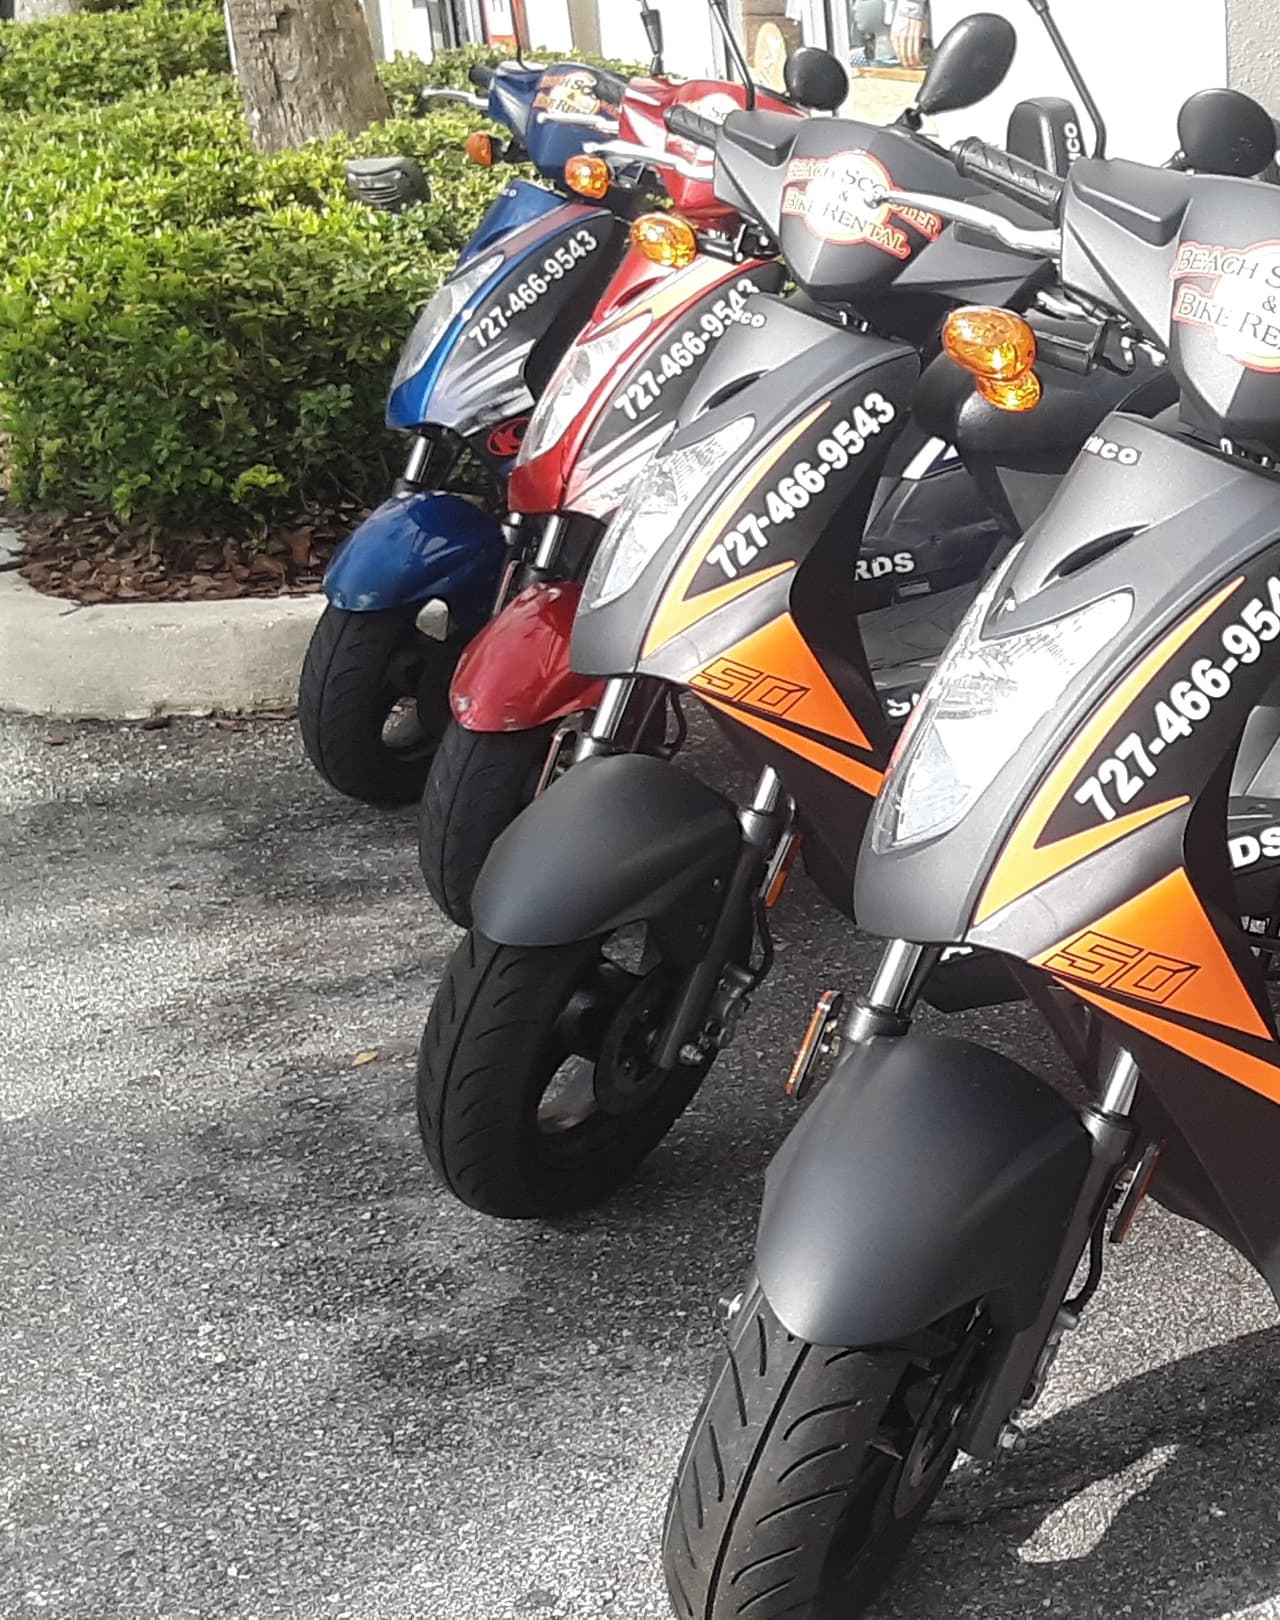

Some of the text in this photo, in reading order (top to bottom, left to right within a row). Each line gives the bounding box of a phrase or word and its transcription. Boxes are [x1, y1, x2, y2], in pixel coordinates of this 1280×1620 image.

[822, 202, 908, 253] RENTAL
[468, 229, 598, 348] 727-466-9543
[1176, 248, 1259, 281] BEACH
[1177, 291, 1232, 328] BIKE
[1261, 294, 1277, 314] &
[705, 392, 896, 579] 727-466-9543
[688, 657, 811, 716] 50
[1042, 931, 1201, 1004] 50
